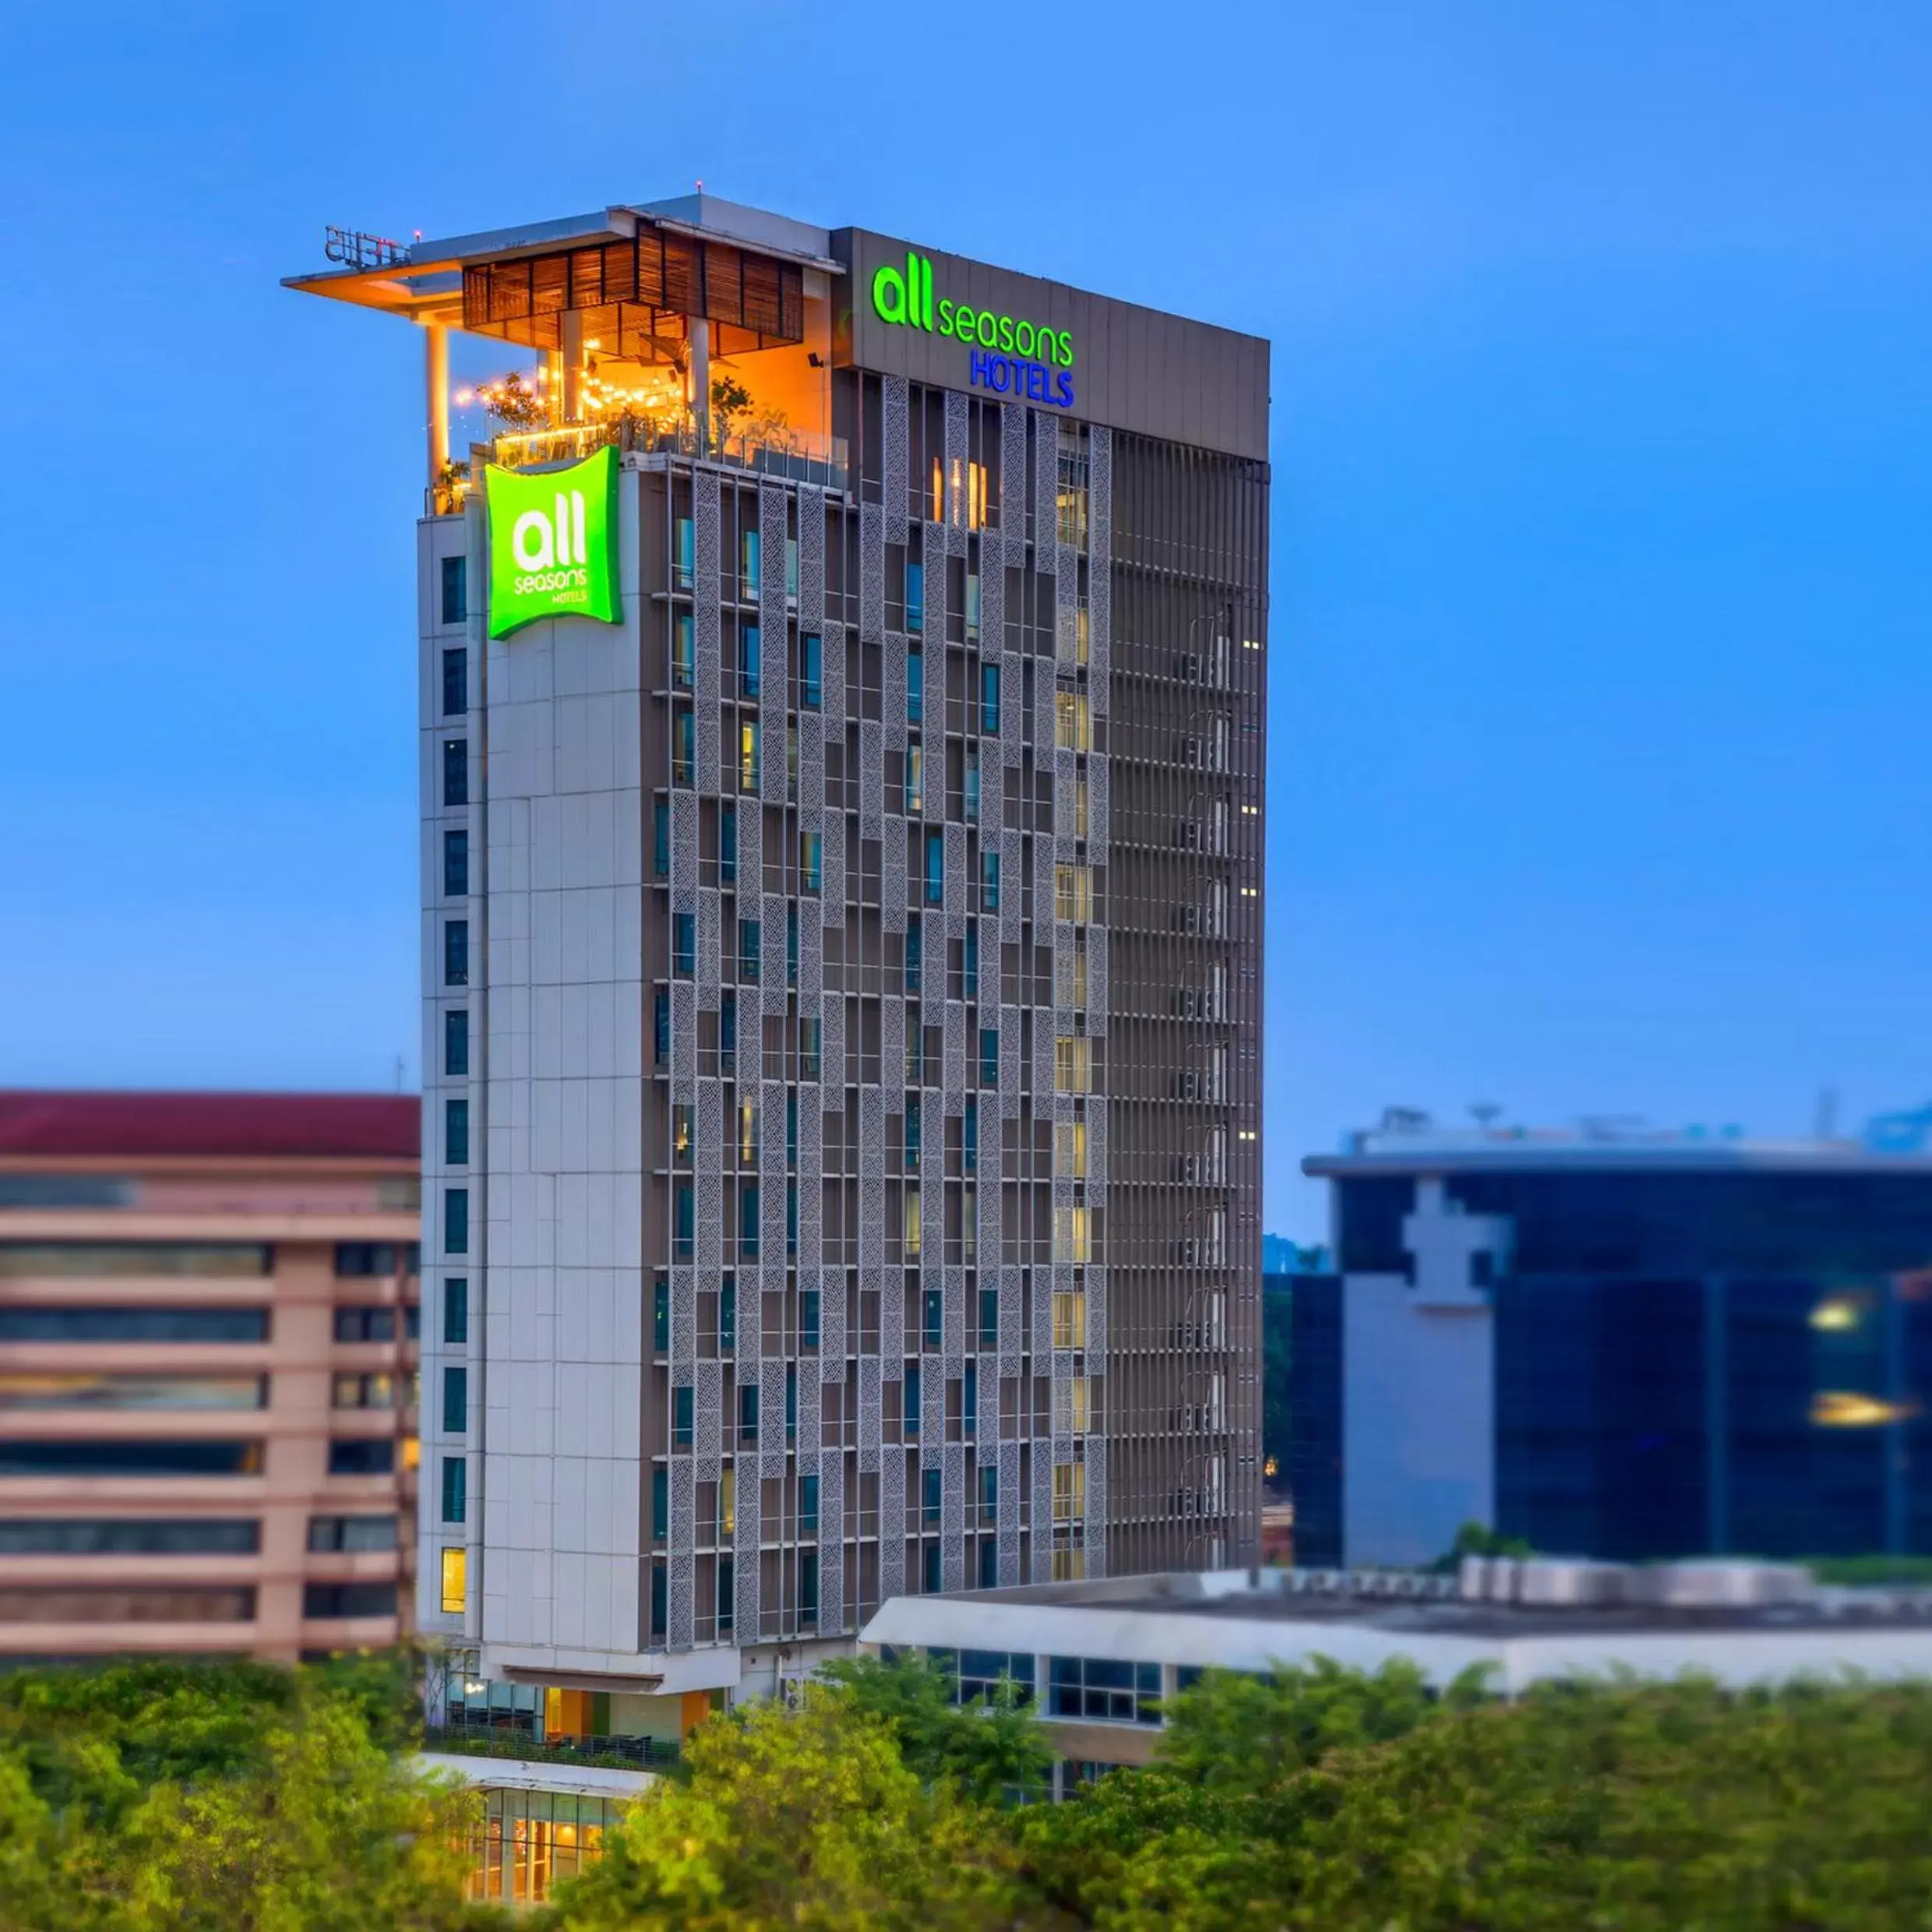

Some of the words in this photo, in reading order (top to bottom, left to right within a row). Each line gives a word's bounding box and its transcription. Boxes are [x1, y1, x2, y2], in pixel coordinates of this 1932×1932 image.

[872, 251, 933, 333] all
[937, 298, 1074, 367] seasons
[970, 349, 1074, 407] HOTELS
[513, 489, 587, 573] all
[514, 568, 587, 594] seasons
[552, 589, 587, 605] HOTELS
